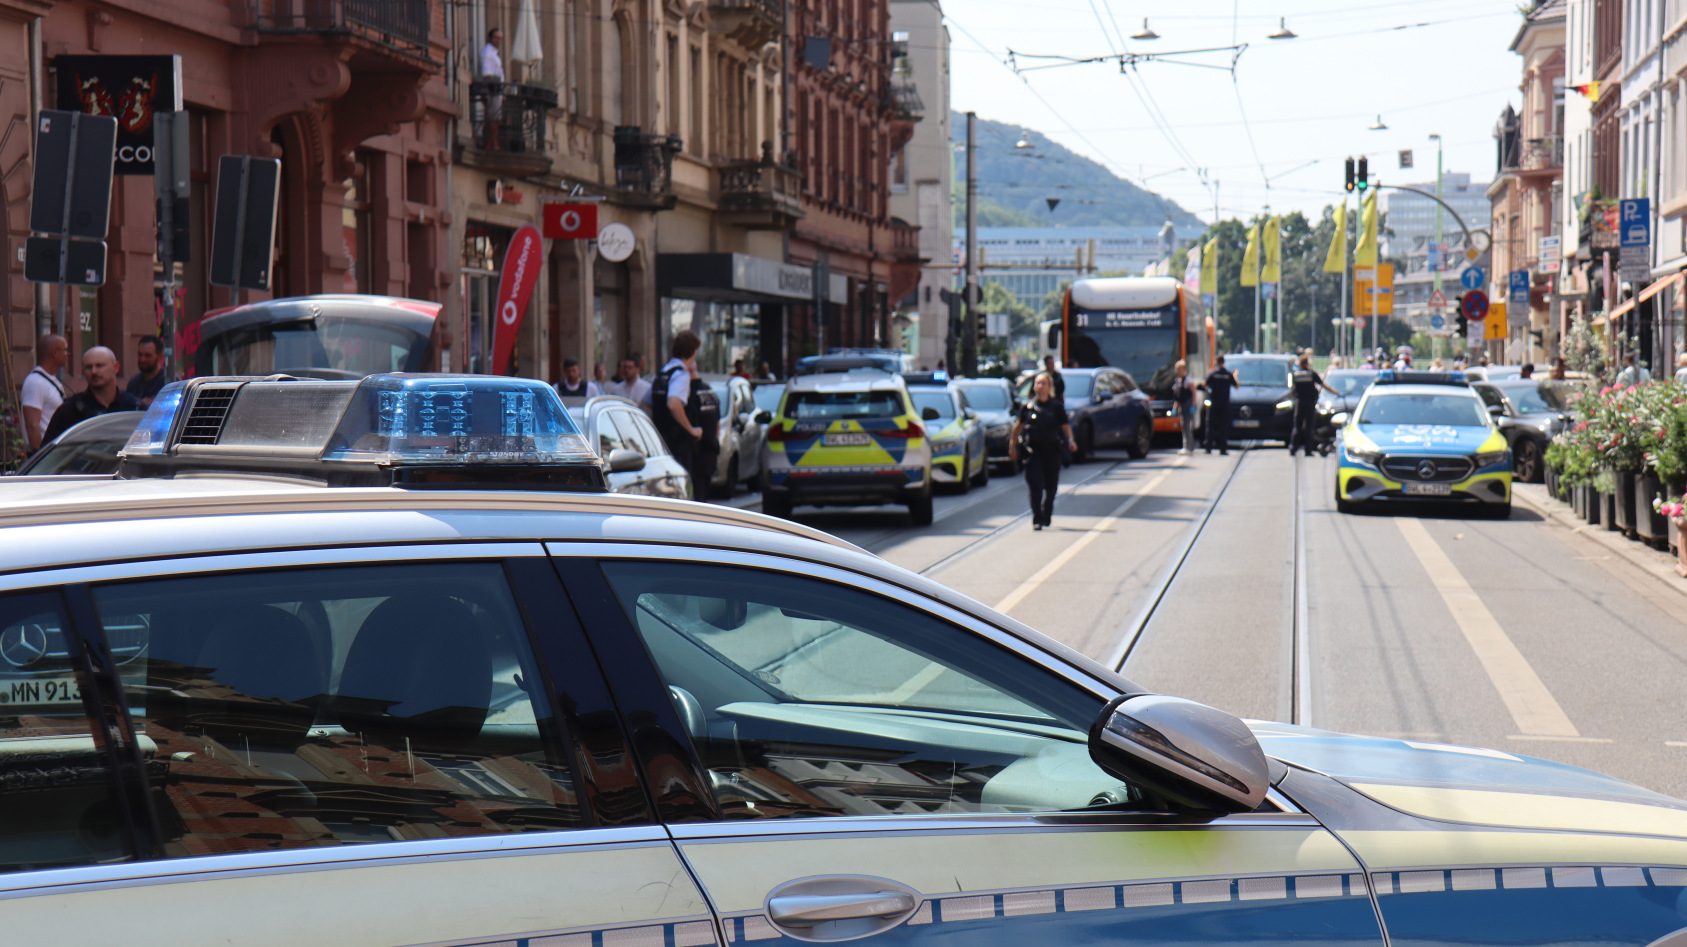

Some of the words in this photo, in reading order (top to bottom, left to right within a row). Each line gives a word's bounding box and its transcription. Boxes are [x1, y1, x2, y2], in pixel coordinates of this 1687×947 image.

[1624, 202, 1638, 221] P
[510, 236, 532, 299] vodafone
[1076, 313, 1089, 327] 31
[12, 681, 40, 702] MN
